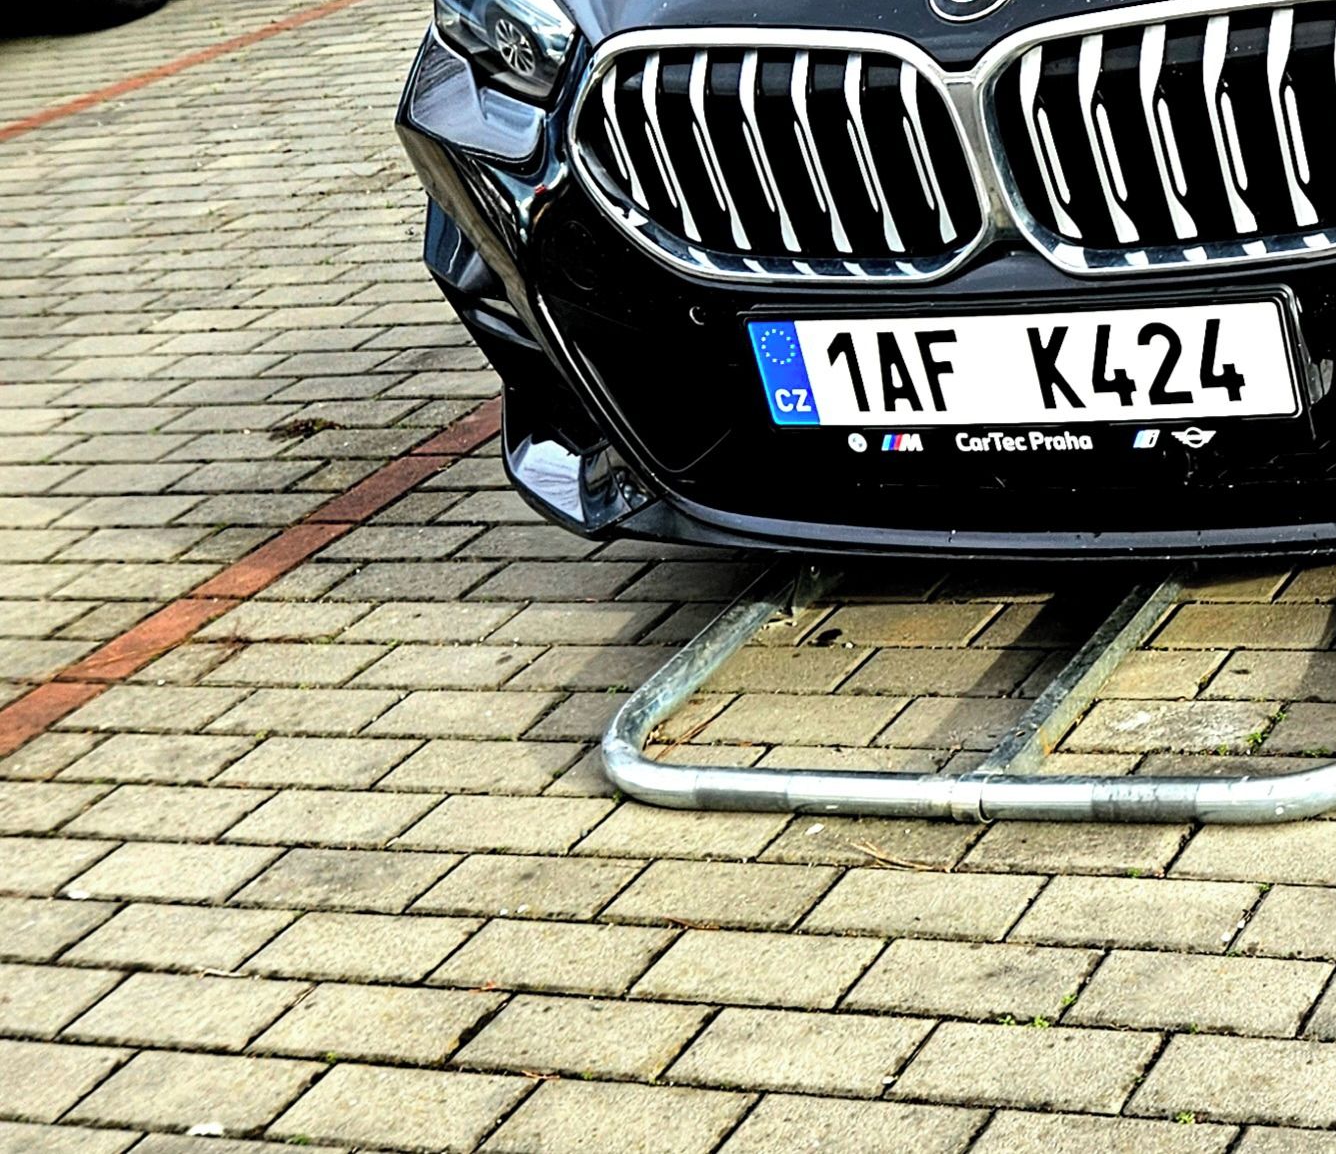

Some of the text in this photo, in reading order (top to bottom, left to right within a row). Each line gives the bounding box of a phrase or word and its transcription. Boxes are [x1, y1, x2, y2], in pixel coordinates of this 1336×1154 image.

[826, 319, 1246, 412] 1AF K424
[774, 388, 812, 413] CZ
[956, 431, 1093, 452] CarTec Praha
